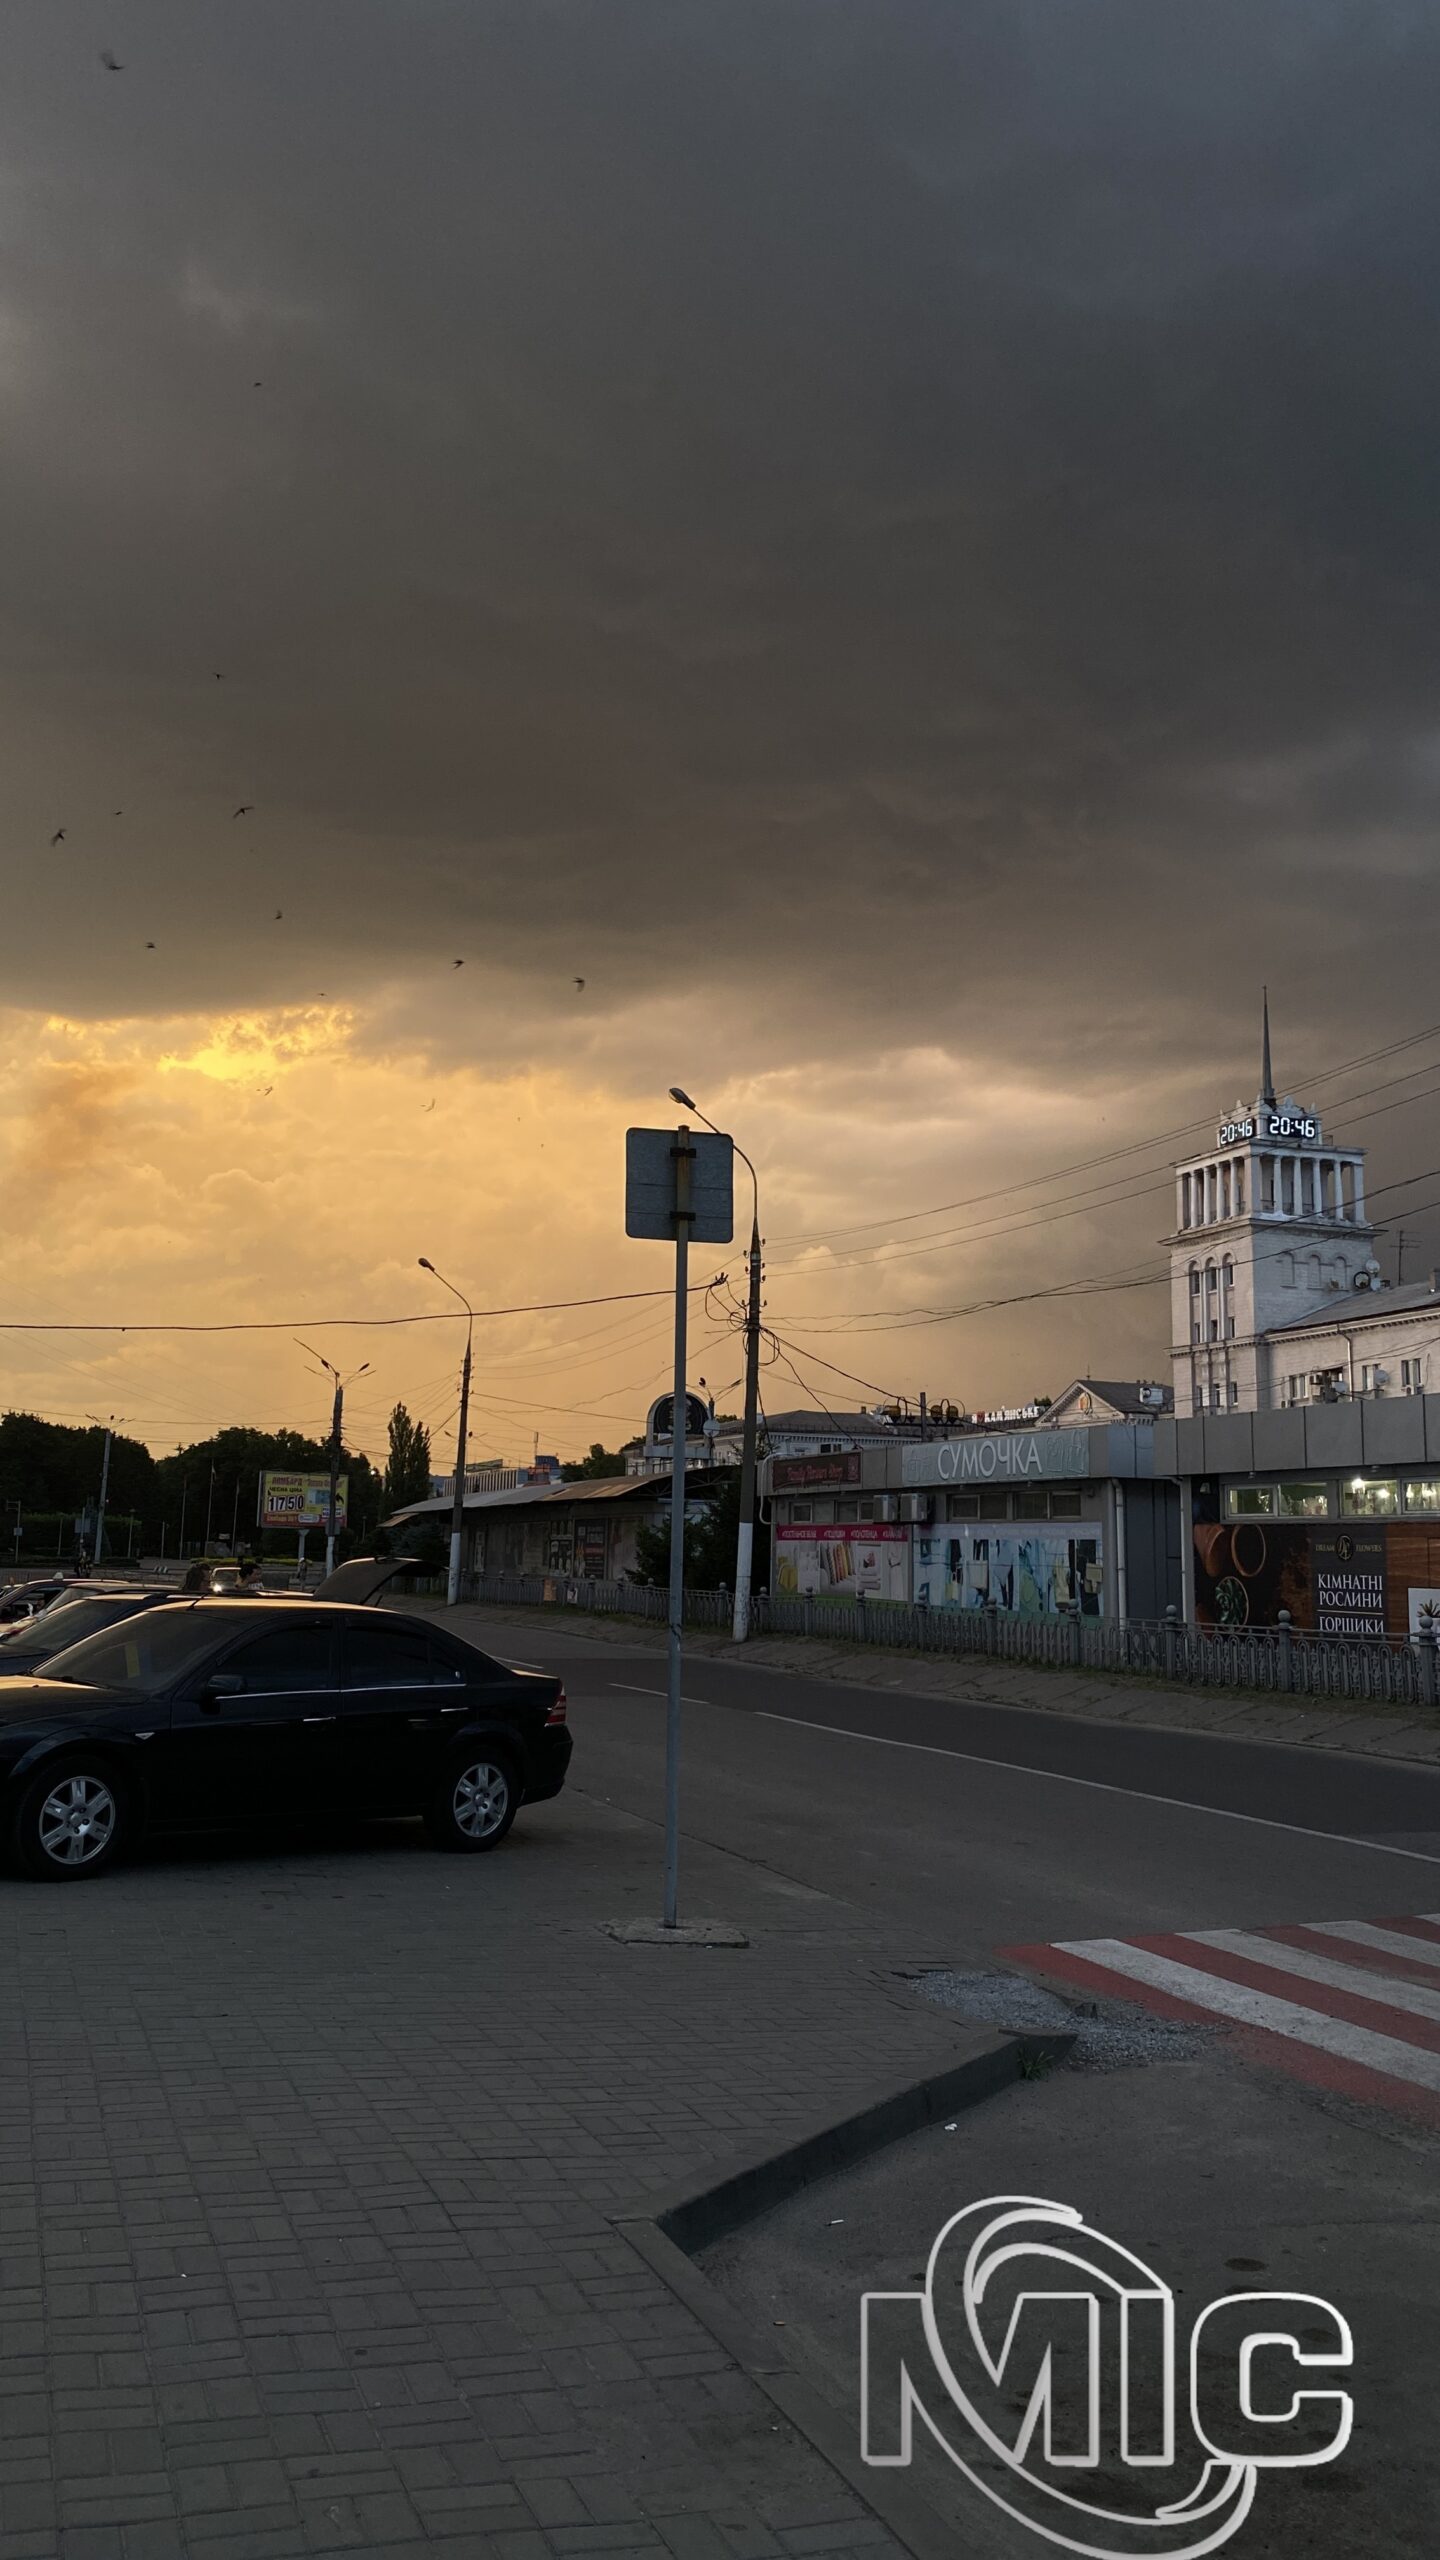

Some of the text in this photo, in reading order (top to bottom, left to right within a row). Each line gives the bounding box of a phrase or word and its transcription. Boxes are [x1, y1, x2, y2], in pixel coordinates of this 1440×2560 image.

[1220, 1118, 1253, 1145] 20:46
[1269, 1116, 1315, 1138] 20:46
[937, 1437, 1043, 1480] СУМОЧКА
[269, 1495, 304, 1511] 1750
[1317, 1573, 1383, 1591] КІМНАТНІ
[1318, 1591, 1383, 1609] РОСЛИНИ
